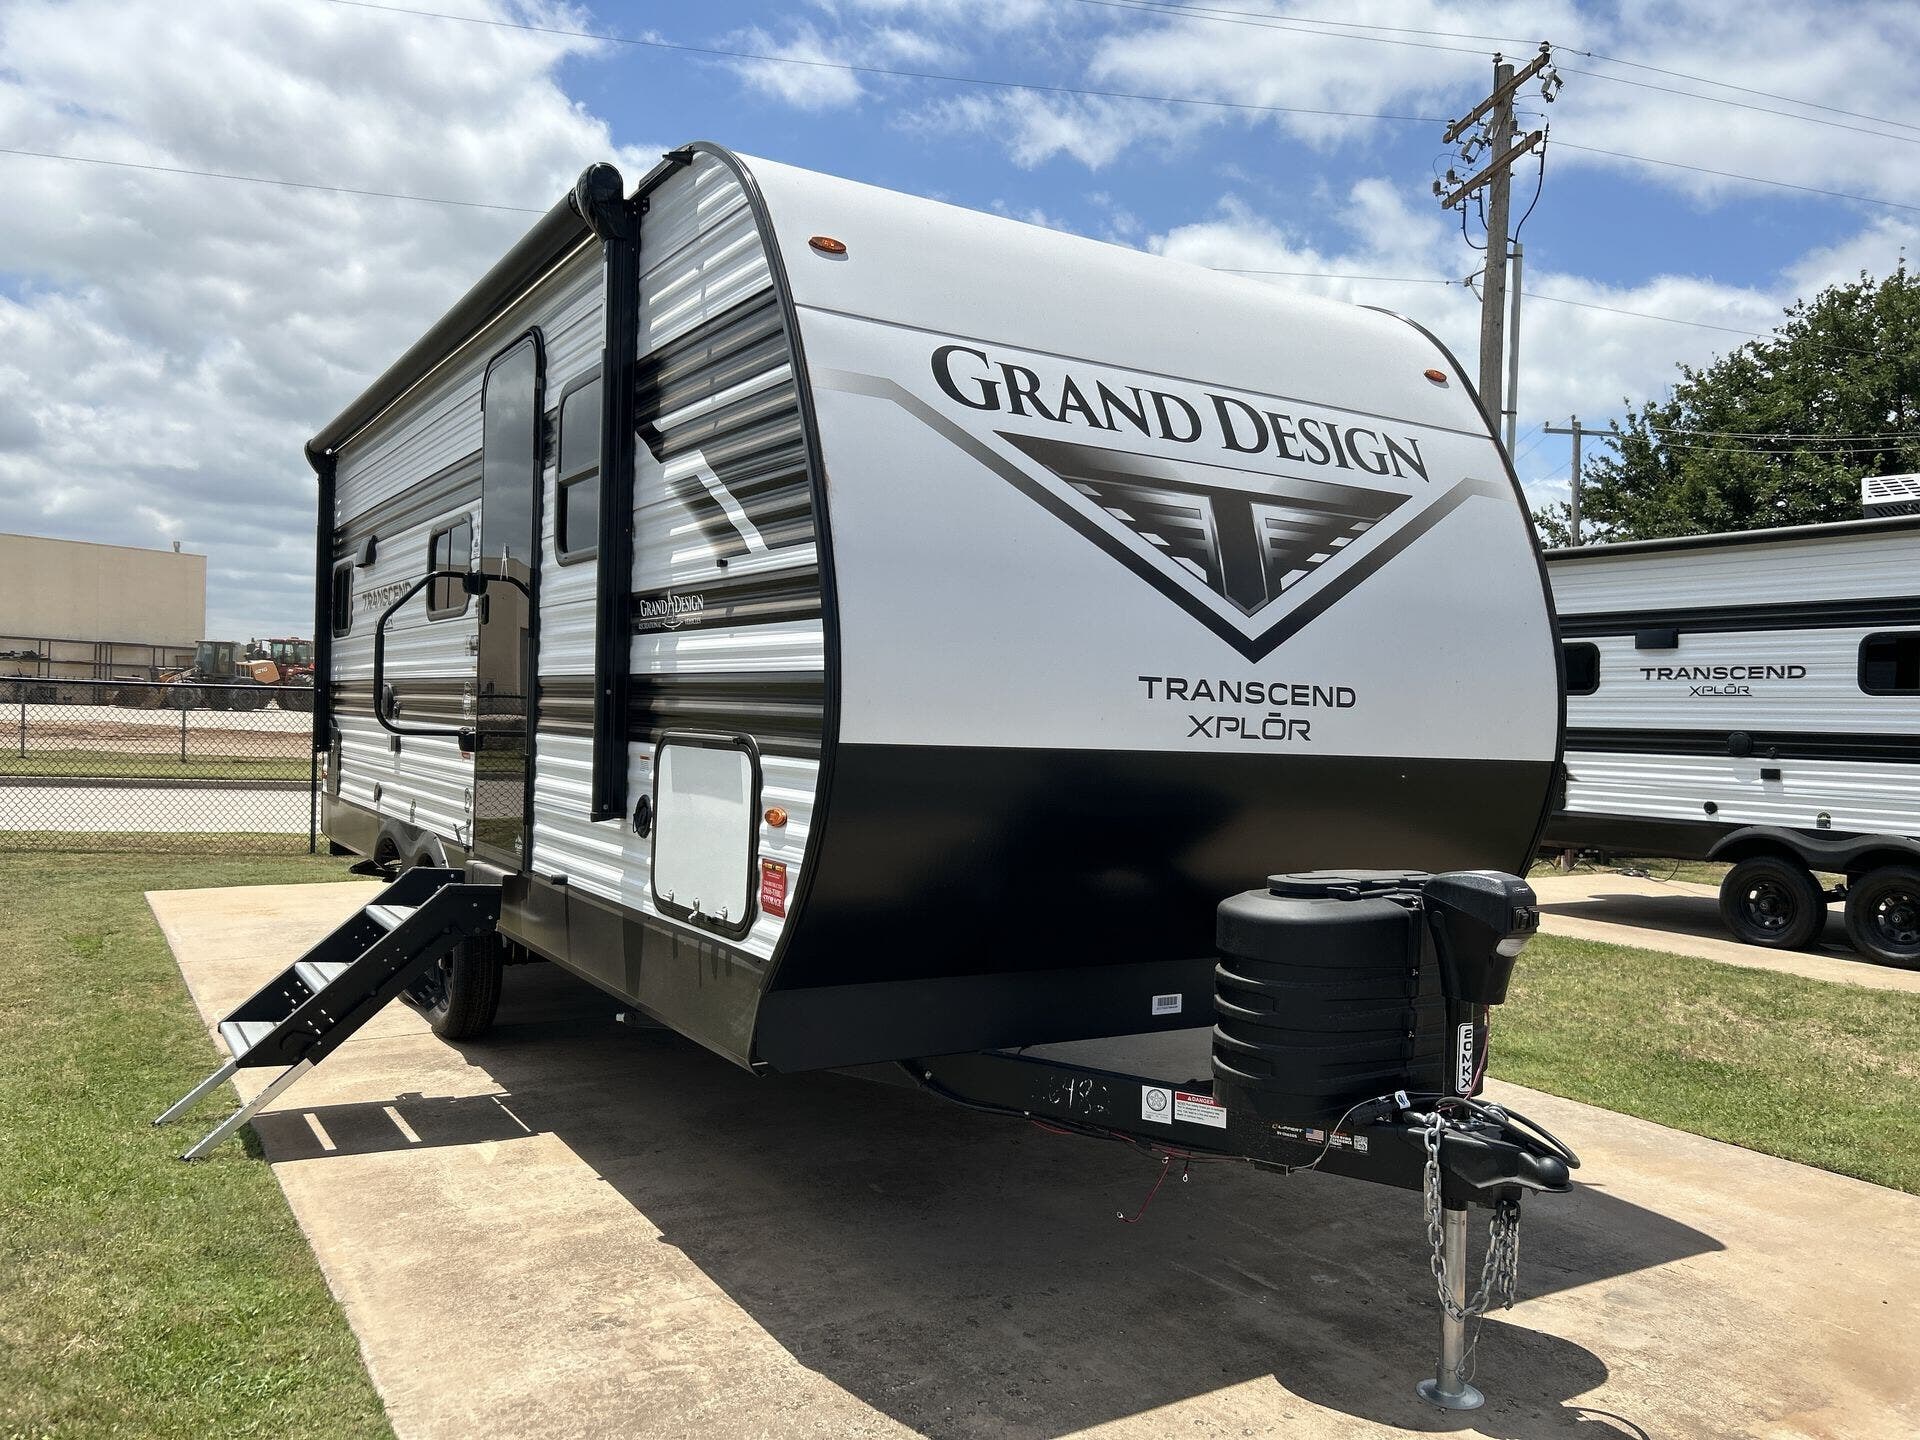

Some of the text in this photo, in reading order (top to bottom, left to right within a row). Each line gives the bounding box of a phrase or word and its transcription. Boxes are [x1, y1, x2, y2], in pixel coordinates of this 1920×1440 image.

[930, 344, 1430, 484] GRAND DESIGN
[639, 594, 704, 617] GRAND DESIGN
[1640, 664, 1807, 681] TRANSCEND
[1138, 675, 1357, 709] TRANSCEND
[1191, 1097, 1214, 1106] DANGER
